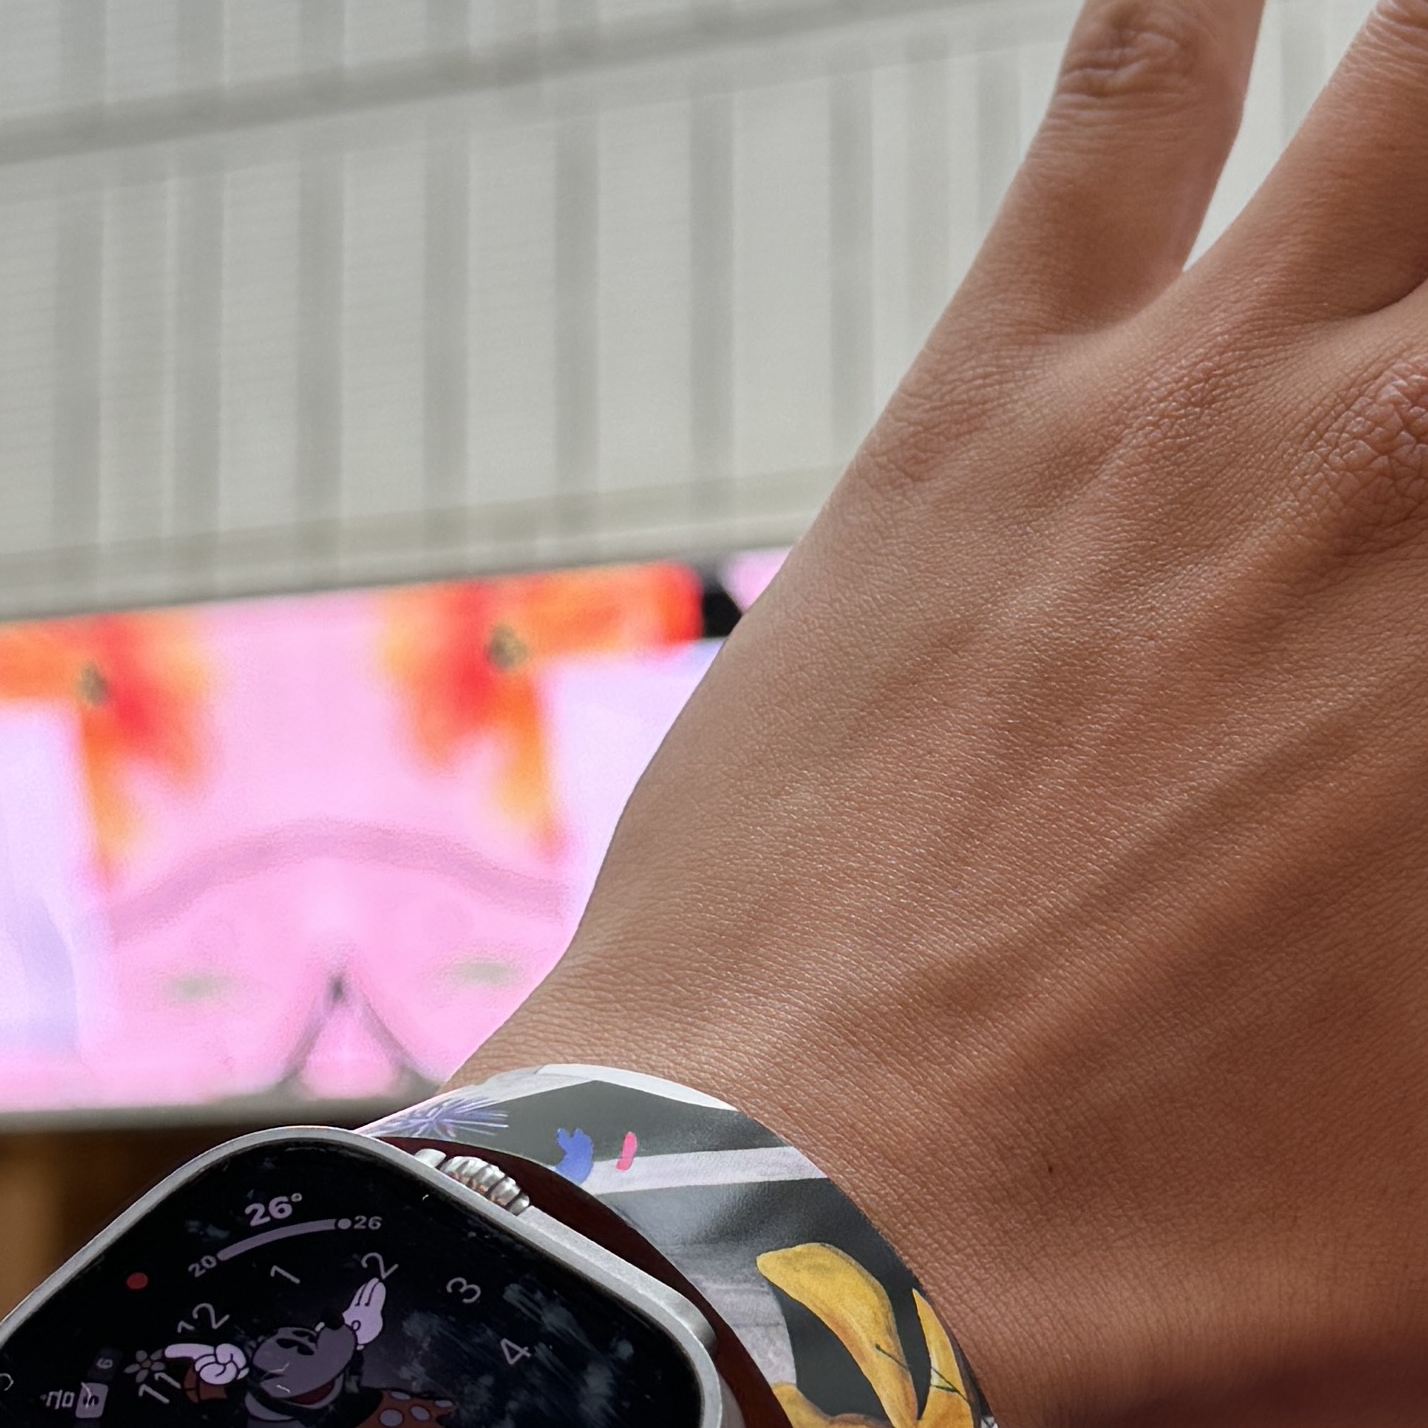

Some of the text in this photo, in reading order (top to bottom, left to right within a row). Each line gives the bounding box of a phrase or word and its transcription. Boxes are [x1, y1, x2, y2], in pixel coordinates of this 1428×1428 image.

[244, 1192, 303, 1227] 26°
[353, 1215, 383, 1230] 26
[188, 1254, 217, 1278] 20
[270, 1264, 301, 1284] 1
[360, 1252, 399, 1280] 2
[446, 1276, 482, 1304] 3
[500, 1337, 535, 1367] 4
[137, 1372, 182, 1404] 11
